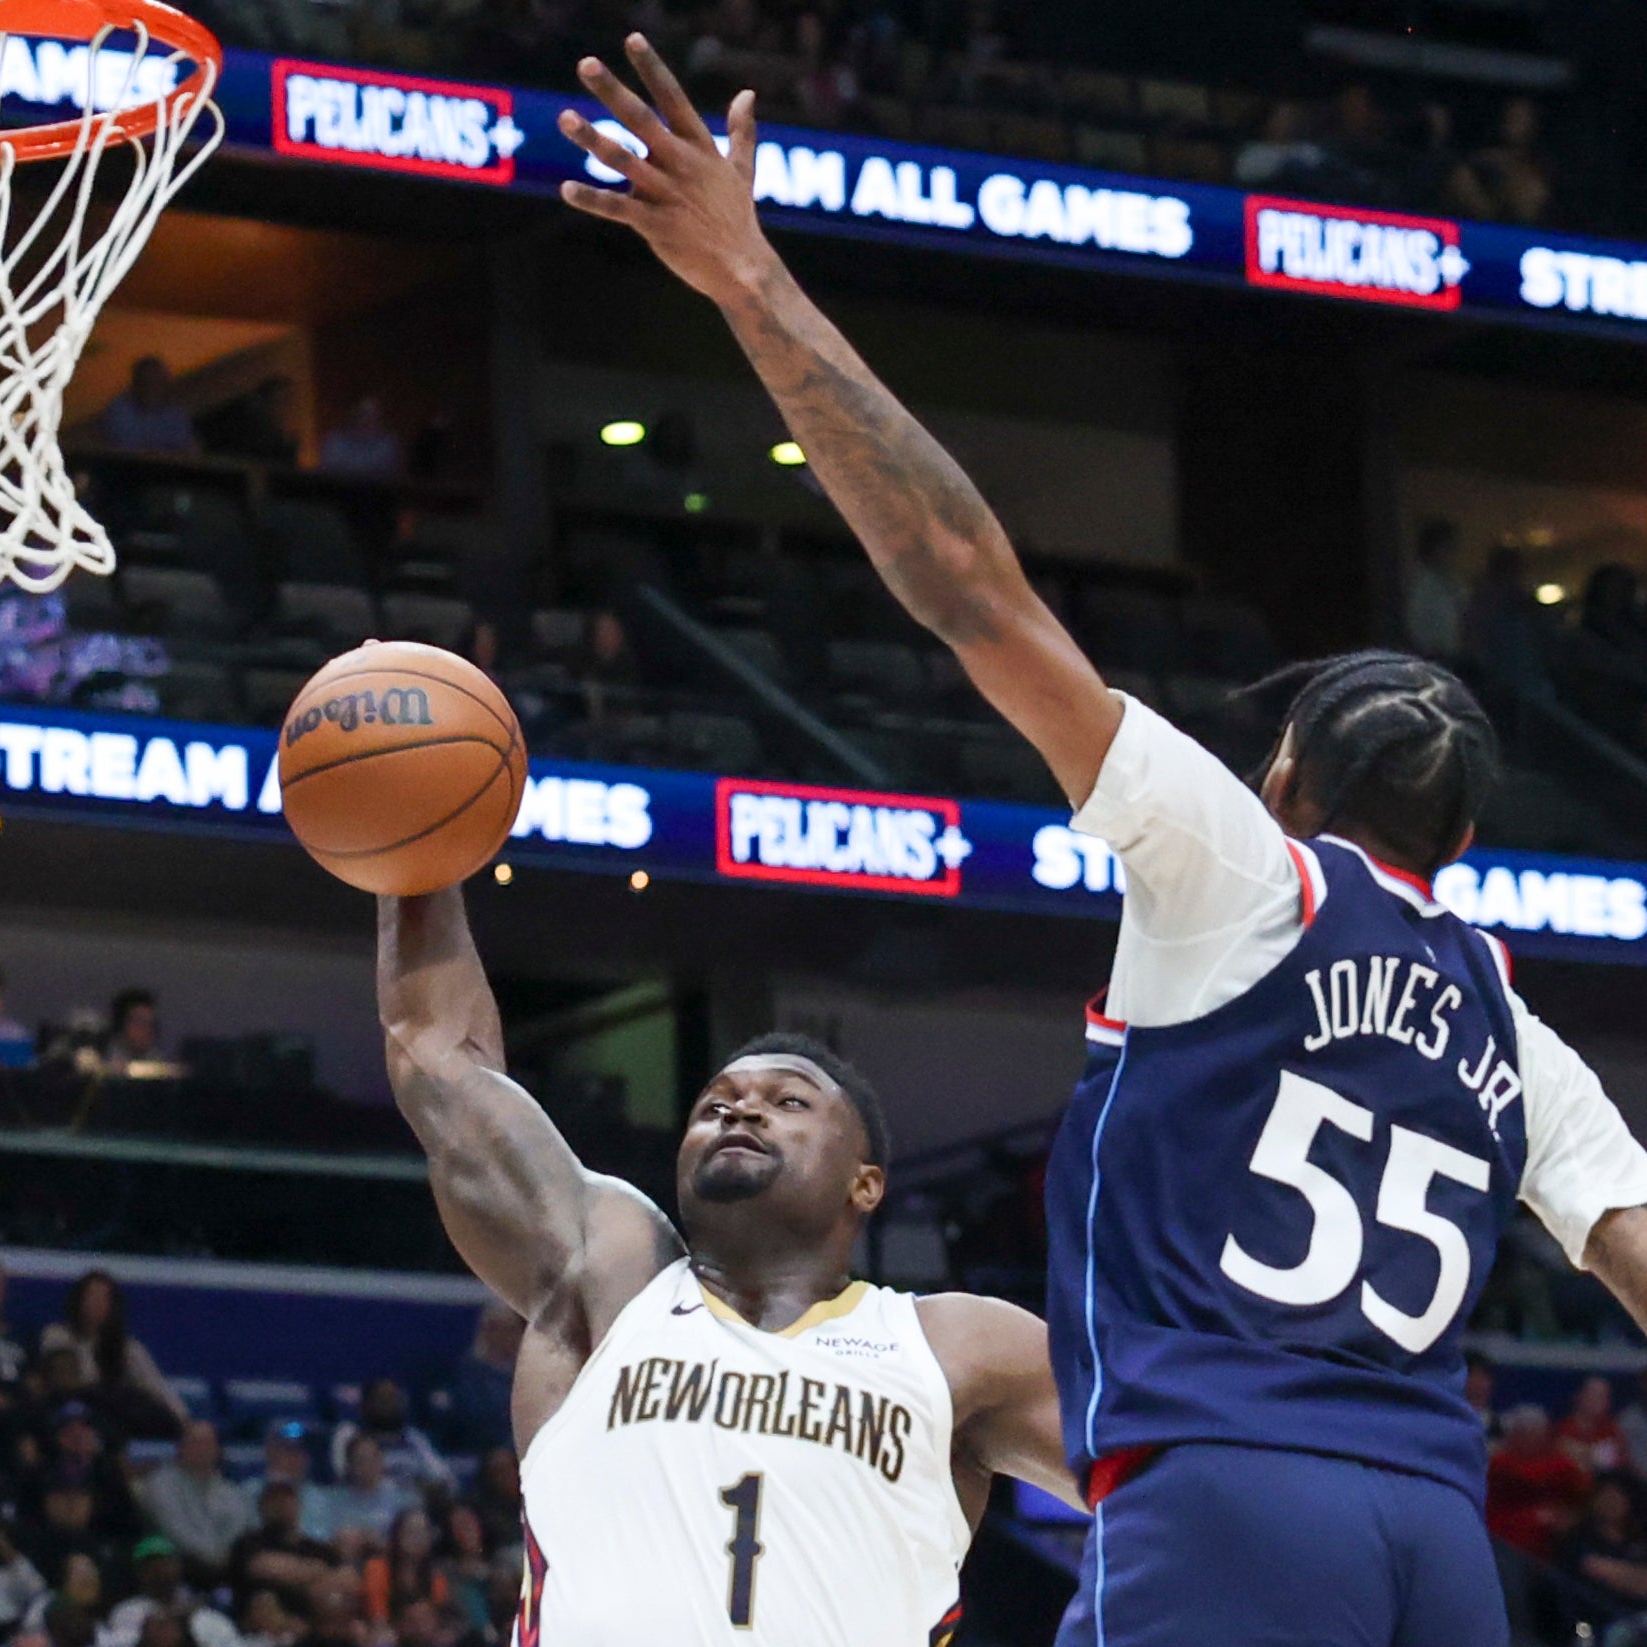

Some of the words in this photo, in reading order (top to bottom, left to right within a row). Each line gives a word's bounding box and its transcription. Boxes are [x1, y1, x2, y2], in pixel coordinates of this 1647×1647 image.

[285, 74, 524, 169] PELICANS+
[851, 156, 975, 229] ALL
[978, 174, 1194, 257] GAMES
[1257, 209, 1470, 295] PELICANS+
[729, 794, 972, 882] PELICANS+
[1304, 955, 1463, 1061] JONES
[1219, 1068, 1492, 1355] 55
[606, 1356, 721, 1433] NEW
[713, 1368, 913, 1484] ORLEANS
[717, 1470, 766, 1631] 1
